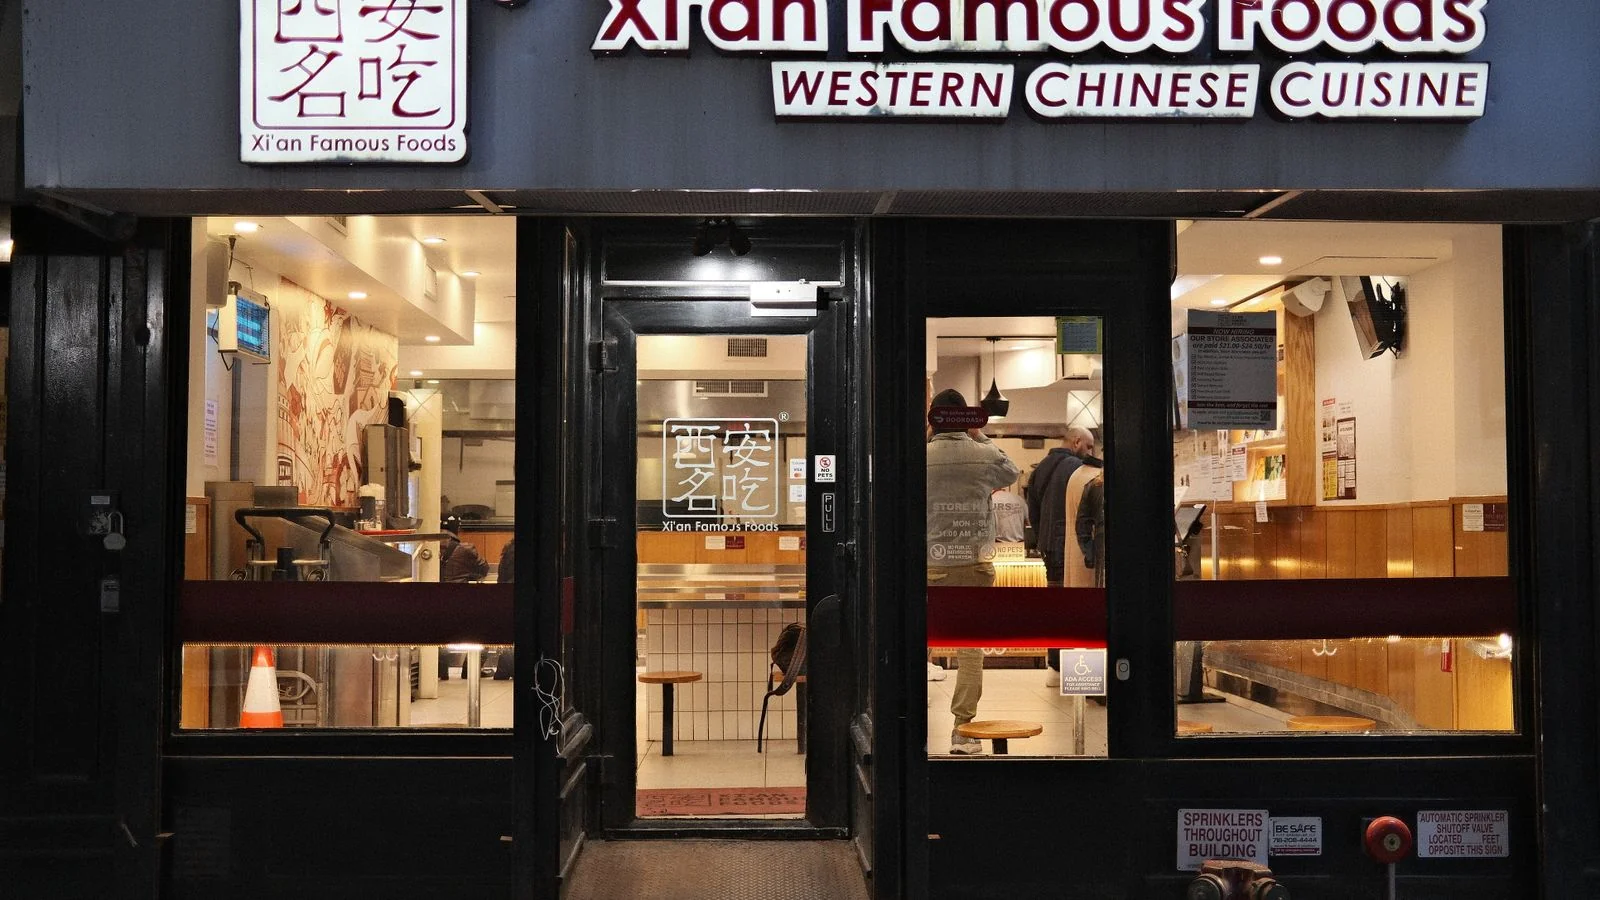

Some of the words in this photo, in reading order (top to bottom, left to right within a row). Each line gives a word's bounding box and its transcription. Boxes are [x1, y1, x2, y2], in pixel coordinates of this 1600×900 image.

[1231, 0, 1476, 42] Foods
[267, 44, 441, 118] 名吃
[781, 70, 1004, 108] WESTERN
[1035, 71, 1249, 108] CHINESE
[1279, 71, 1477, 108] CUISINE
[251, 134, 301, 151] Xi'an
[310, 134, 390, 151] Famous
[397, 134, 456, 151] Foods
[1231, 335, 1274, 343] ASSOCIATES
[671, 423, 772, 468] 西安
[671, 468, 770, 511] 名吃
[933, 502, 969, 511] STORE
[662, 521, 692, 532] Xi'an
[745, 521, 779, 532] Foods
[1183, 812, 1263, 826] SPRINKLERS
[1421, 813, 1463, 823] AUTOMATIC
[1464, 813, 1505, 823] SPRINKLER
[1184, 828, 1263, 842] THROUGHOUT
[1275, 824, 1289, 833] BE
[1290, 823, 1316, 833] SAFE
[1436, 824, 1470, 833] SHUTOFF
[1472, 824, 1493, 833] VALVE
[1429, 834, 1462, 844] LOCATED
[1482, 834, 1500, 844] FEET
[1189, 843, 1256, 857] BUILDING
[1429, 845, 1464, 855] OPPOSITE
[1466, 845, 1484, 855] THIS
[1485, 845, 1503, 855] SIGN
